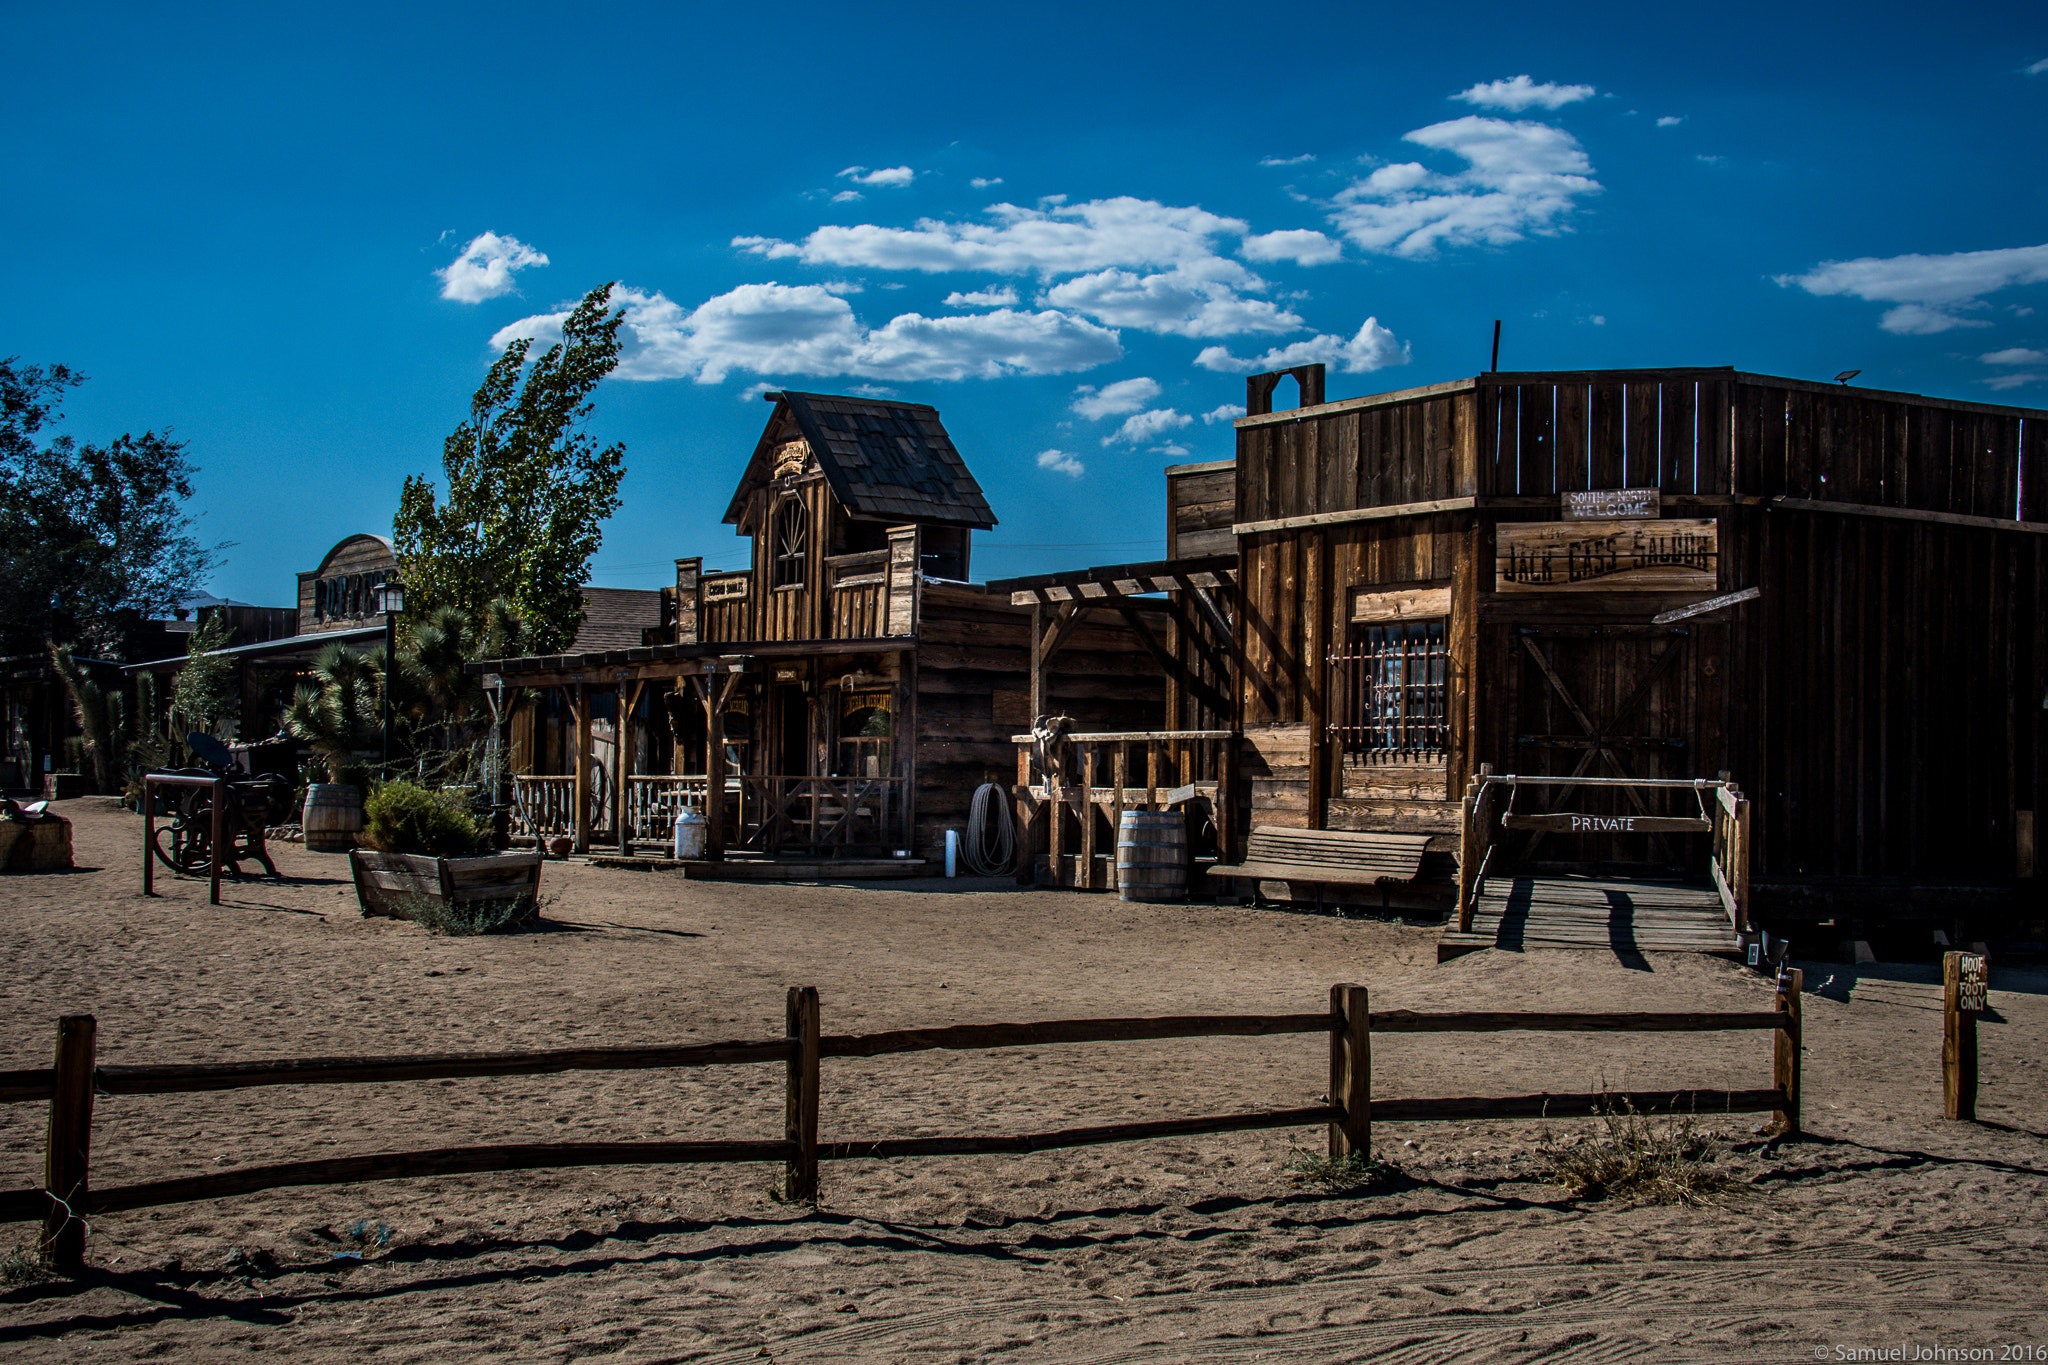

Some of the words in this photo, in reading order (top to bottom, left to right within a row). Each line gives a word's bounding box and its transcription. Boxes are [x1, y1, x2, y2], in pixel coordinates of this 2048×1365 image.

[1570, 491, 1604, 504] SOUTH
[1617, 490, 1651, 502] NORTH
[1571, 502, 1648, 517] WELCOME
[1571, 816, 1635, 831] PRIVATE
[1961, 956, 1984, 973] HOOF
[1959, 982, 1986, 996] FOOT
[1960, 995, 1986, 1011] ONLY
